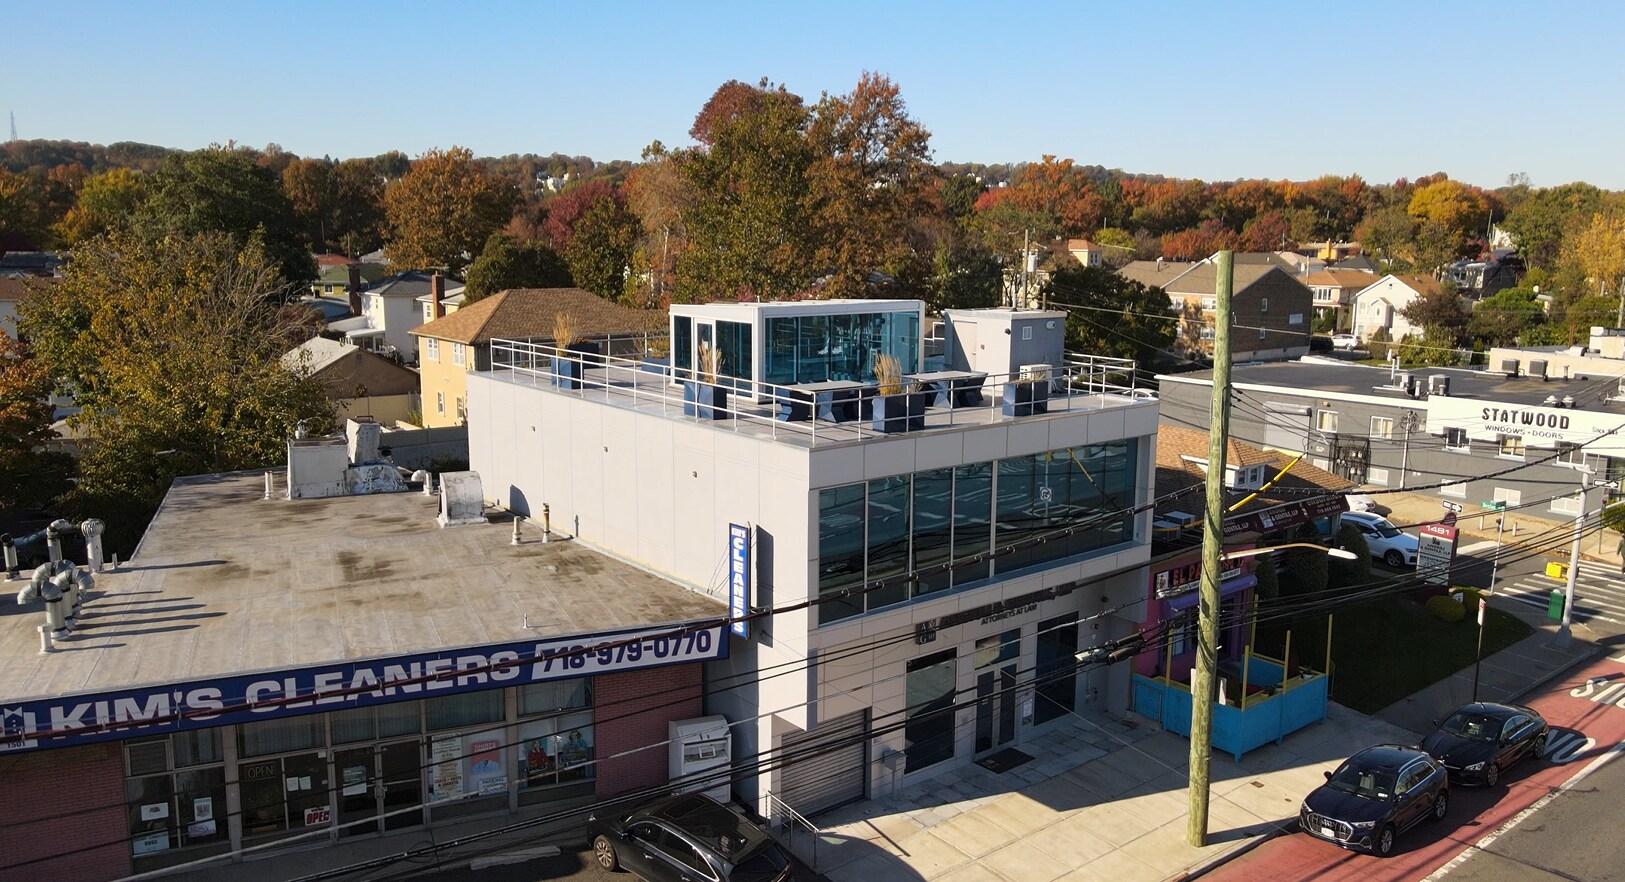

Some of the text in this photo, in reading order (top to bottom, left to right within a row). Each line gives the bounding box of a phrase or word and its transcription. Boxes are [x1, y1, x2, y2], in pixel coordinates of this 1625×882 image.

[1482, 407, 1570, 430] STATWOOD
[1484, 424, 1564, 440] WINDOWS DOORS
[1426, 525, 1450, 536] 1481
[732, 537, 745, 633] CLEANERS
[981, 604, 1038, 626] ATTORNEYS AT LAW
[50, 630, 712, 740] KIM'S CLEANERS 718-979-0770
[247, 765, 274, 779] OPEN
[306, 811, 330, 825] OPEN
